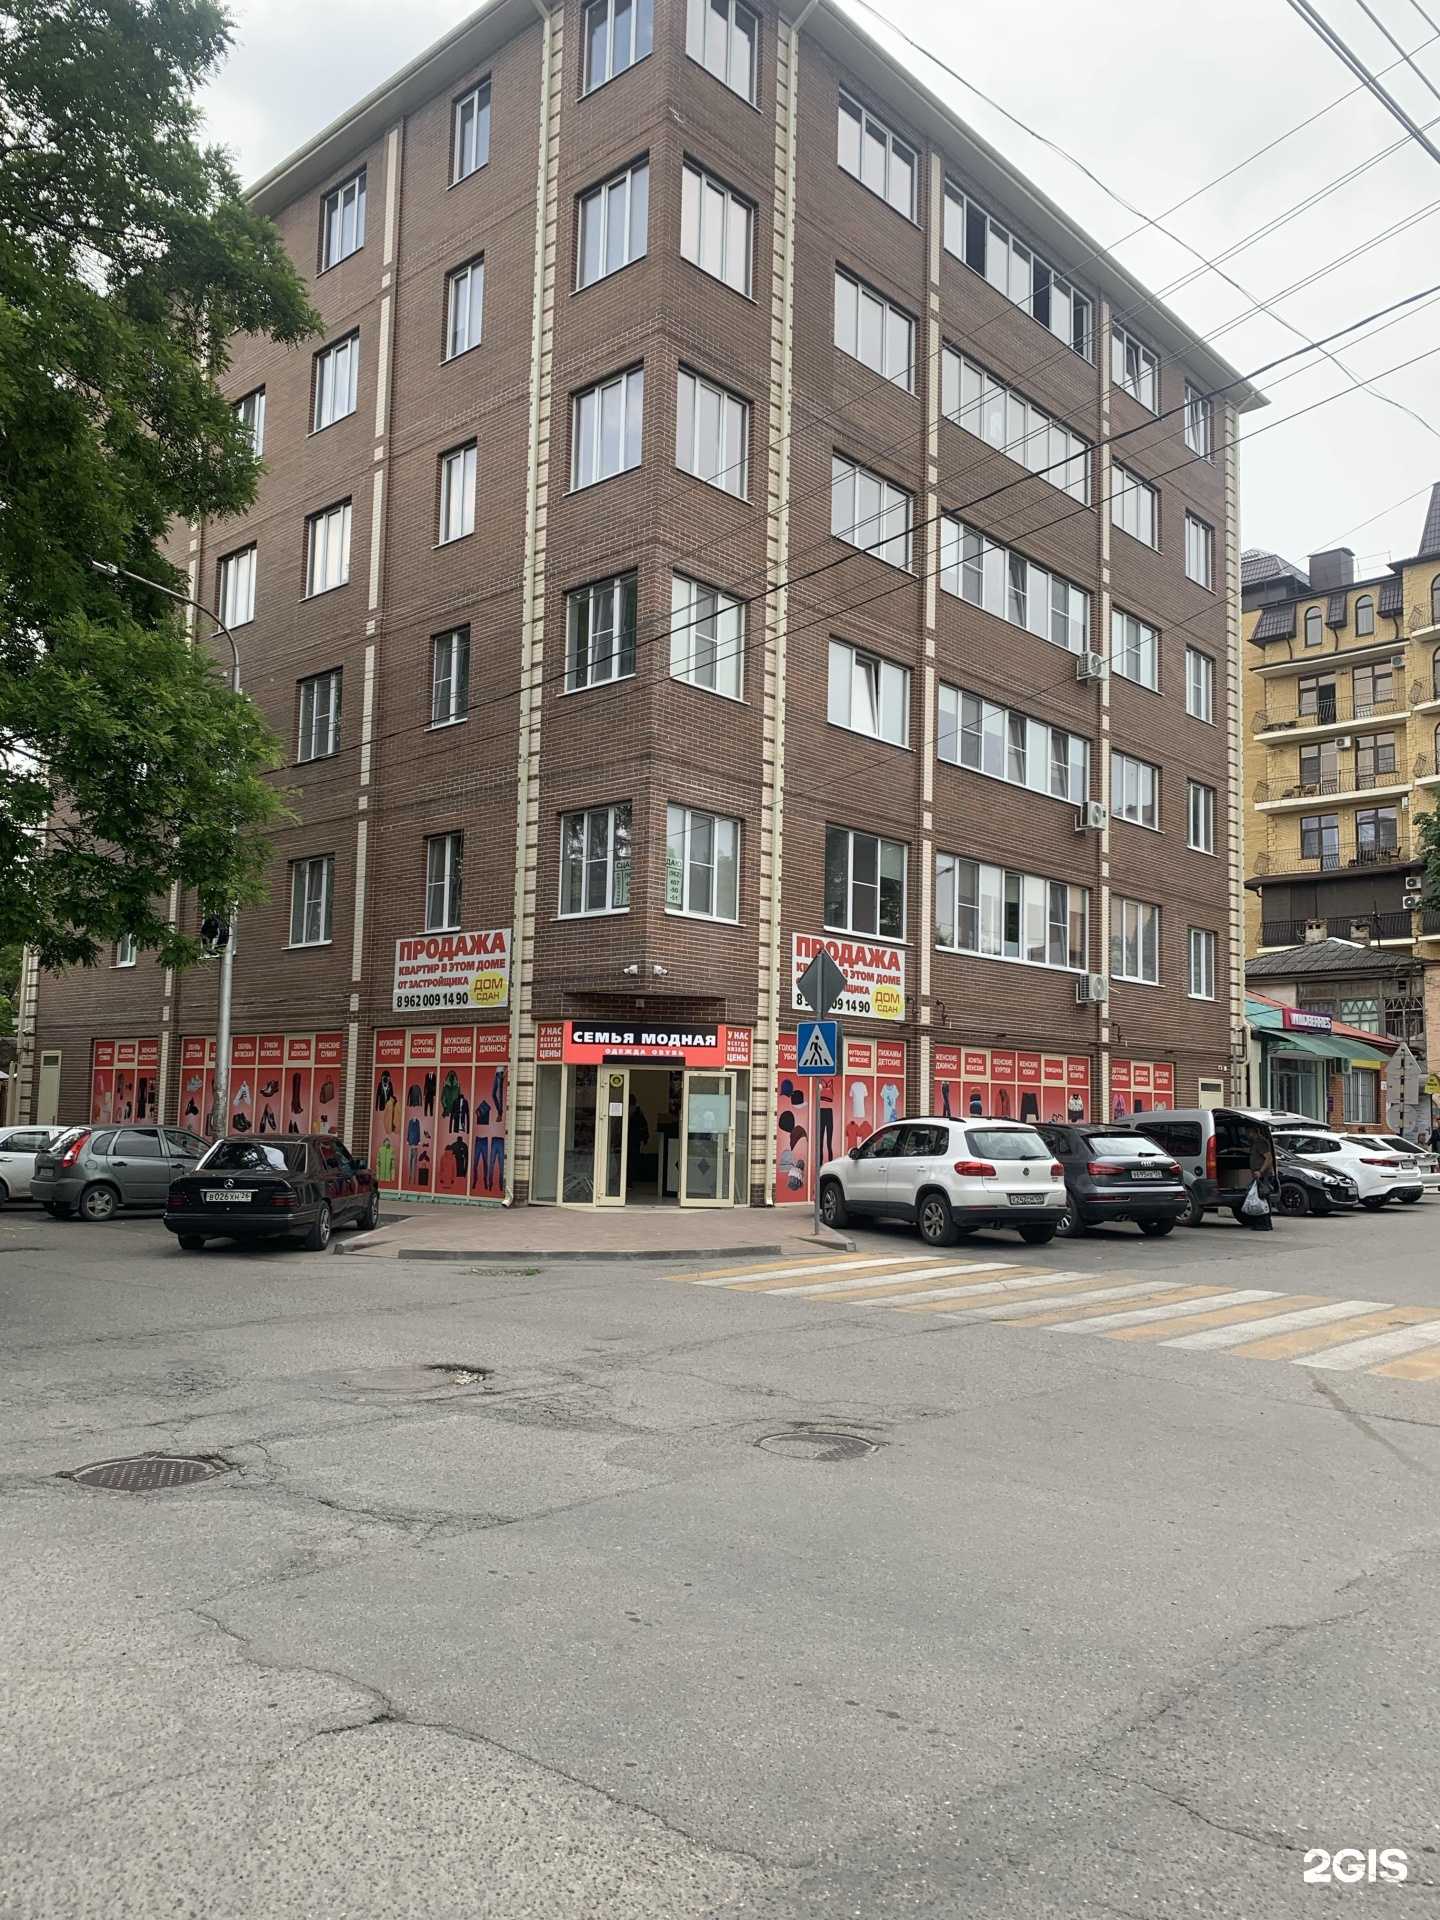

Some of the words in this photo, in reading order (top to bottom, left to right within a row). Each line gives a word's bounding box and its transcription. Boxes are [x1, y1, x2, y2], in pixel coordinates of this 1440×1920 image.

[400, 932, 506, 961] ПРОДАЖА
[796, 936, 901, 971] ПРОДАЖА
[399, 963, 440, 976] КВАРТИР
[441, 963, 447, 973] В
[449, 960, 476, 972] ЭТОМ
[476, 958, 506, 972] ДОМЕ
[398, 979, 408, 990] ОТ
[408, 975, 470, 989] ЗАСТРОЙЩИКА
[850, 970, 875, 981] ЭТОМ
[876, 975, 901, 986] ДОМЕ
[474, 977, 504, 992] ДОМ
[397, 995, 403, 1007] 8
[404, 994, 421, 1007] 962
[423, 993, 441, 1007] 009
[443, 992, 454, 1005] 14
[456, 991, 469, 1005] 90
[476, 992, 500, 1002] СДАН
[875, 991, 900, 1004] ДОМ
[846, 999, 857, 1012] 14
[858, 1001, 871, 1013] 90
[877, 1005, 898, 1014] СДАН
[540, 1027, 546, 1036] У
[547, 1026, 562, 1036] НАС
[727, 1031, 733, 1039] У
[734, 1031, 749, 1040] НАС
[379, 1038, 403, 1047] МУЖСКИЕ
[444, 1036, 472, 1045] МУЖСКИЕ
[479, 1034, 507, 1043] МУЖСКИЕ
[573, 1031, 635, 1044] СЕМЬЯ
[641, 1033, 717, 1047] МОДНАЯ
[442, 1046, 472, 1054] ВЕТРОВКИ
[479, 1044, 507, 1053] ДЖИНСЫ
[605, 1048, 646, 1056] ОДЕЖДА
[540, 1049, 561, 1059] ЦЕНЫ
[726, 1054, 749, 1062] ЦЕНЫ
